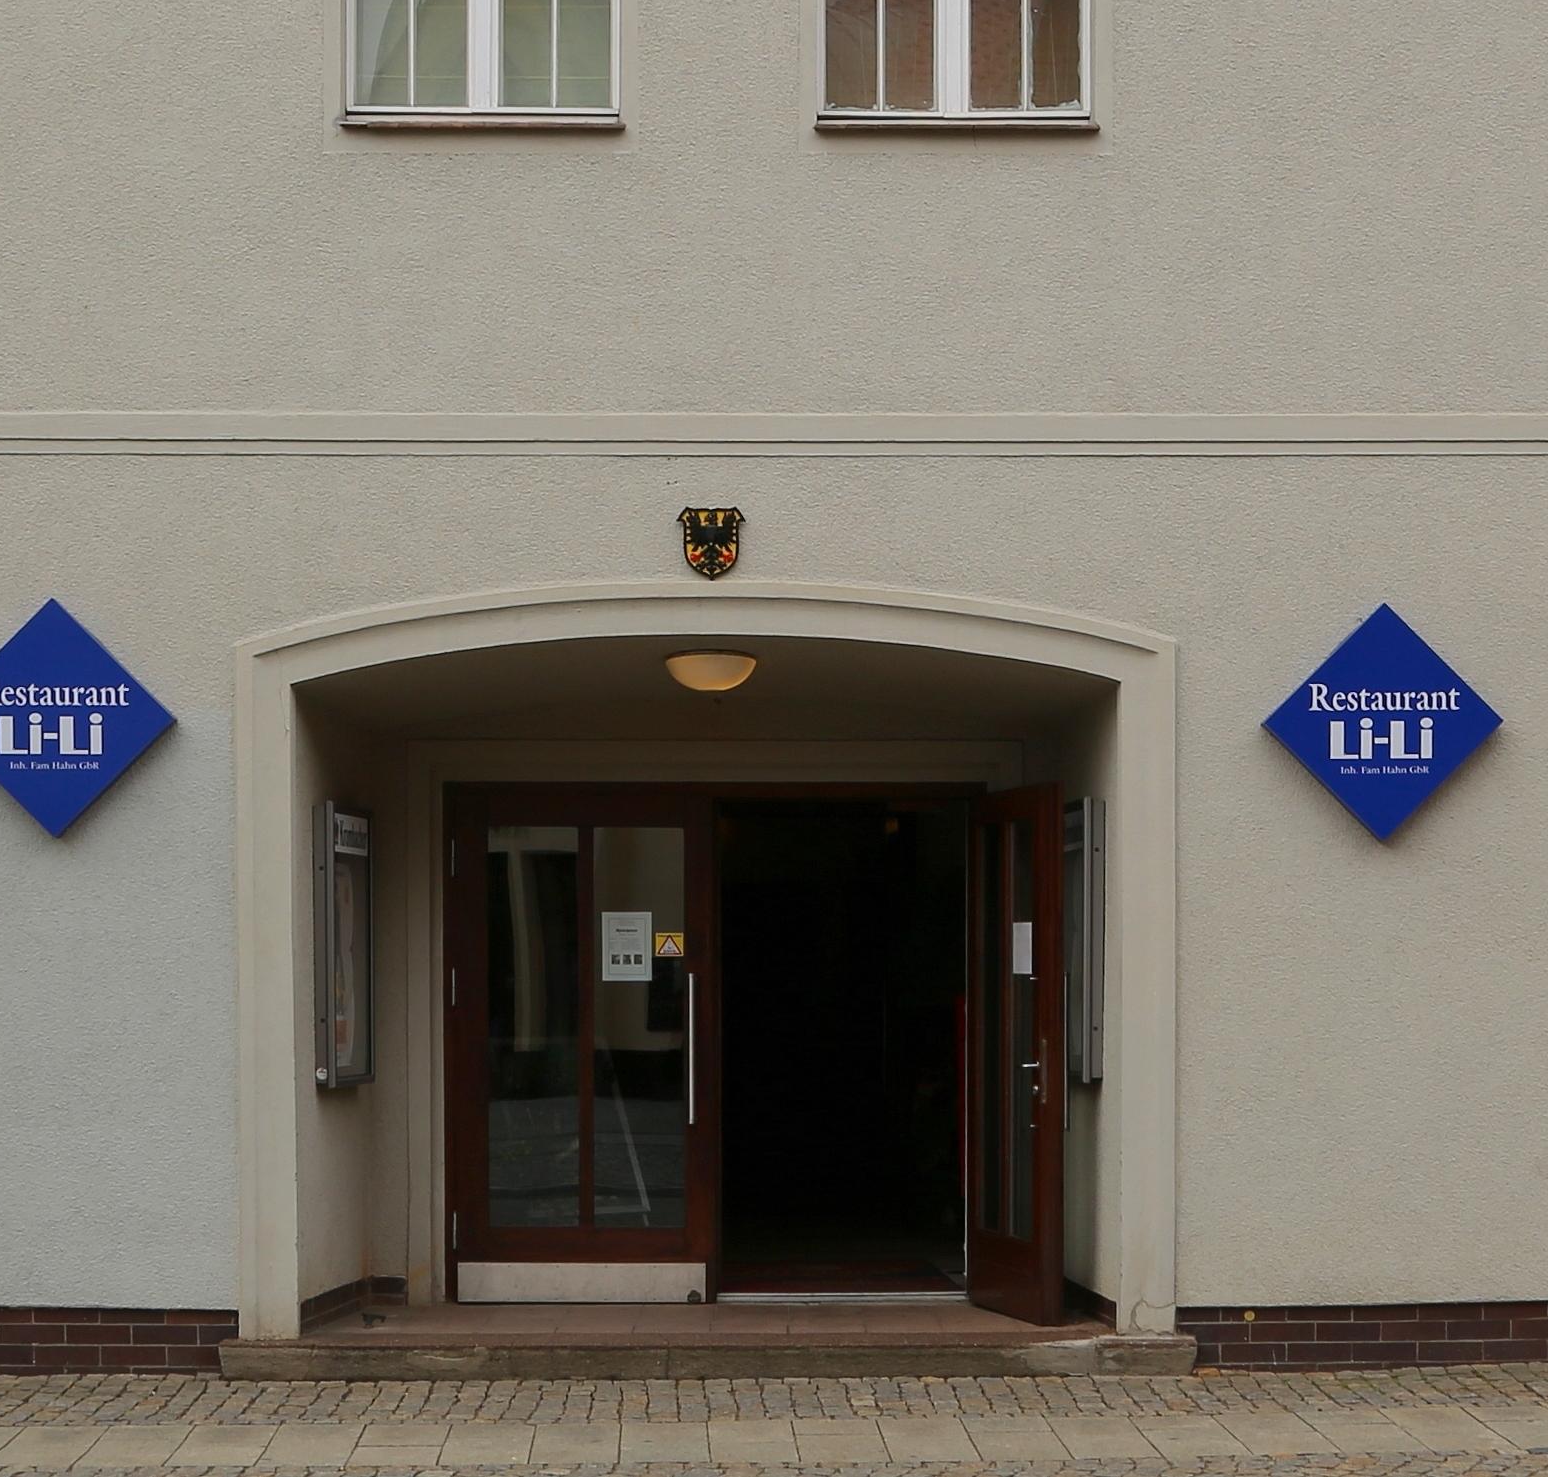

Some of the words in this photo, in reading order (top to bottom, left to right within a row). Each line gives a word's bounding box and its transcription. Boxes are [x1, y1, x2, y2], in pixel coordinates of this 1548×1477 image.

[1308, 683, 1460, 712] Restaurant
[9, 761, 28, 770] Inh.
[52, 761, 77, 770] Hahn
[79, 761, 100, 770] GbR
